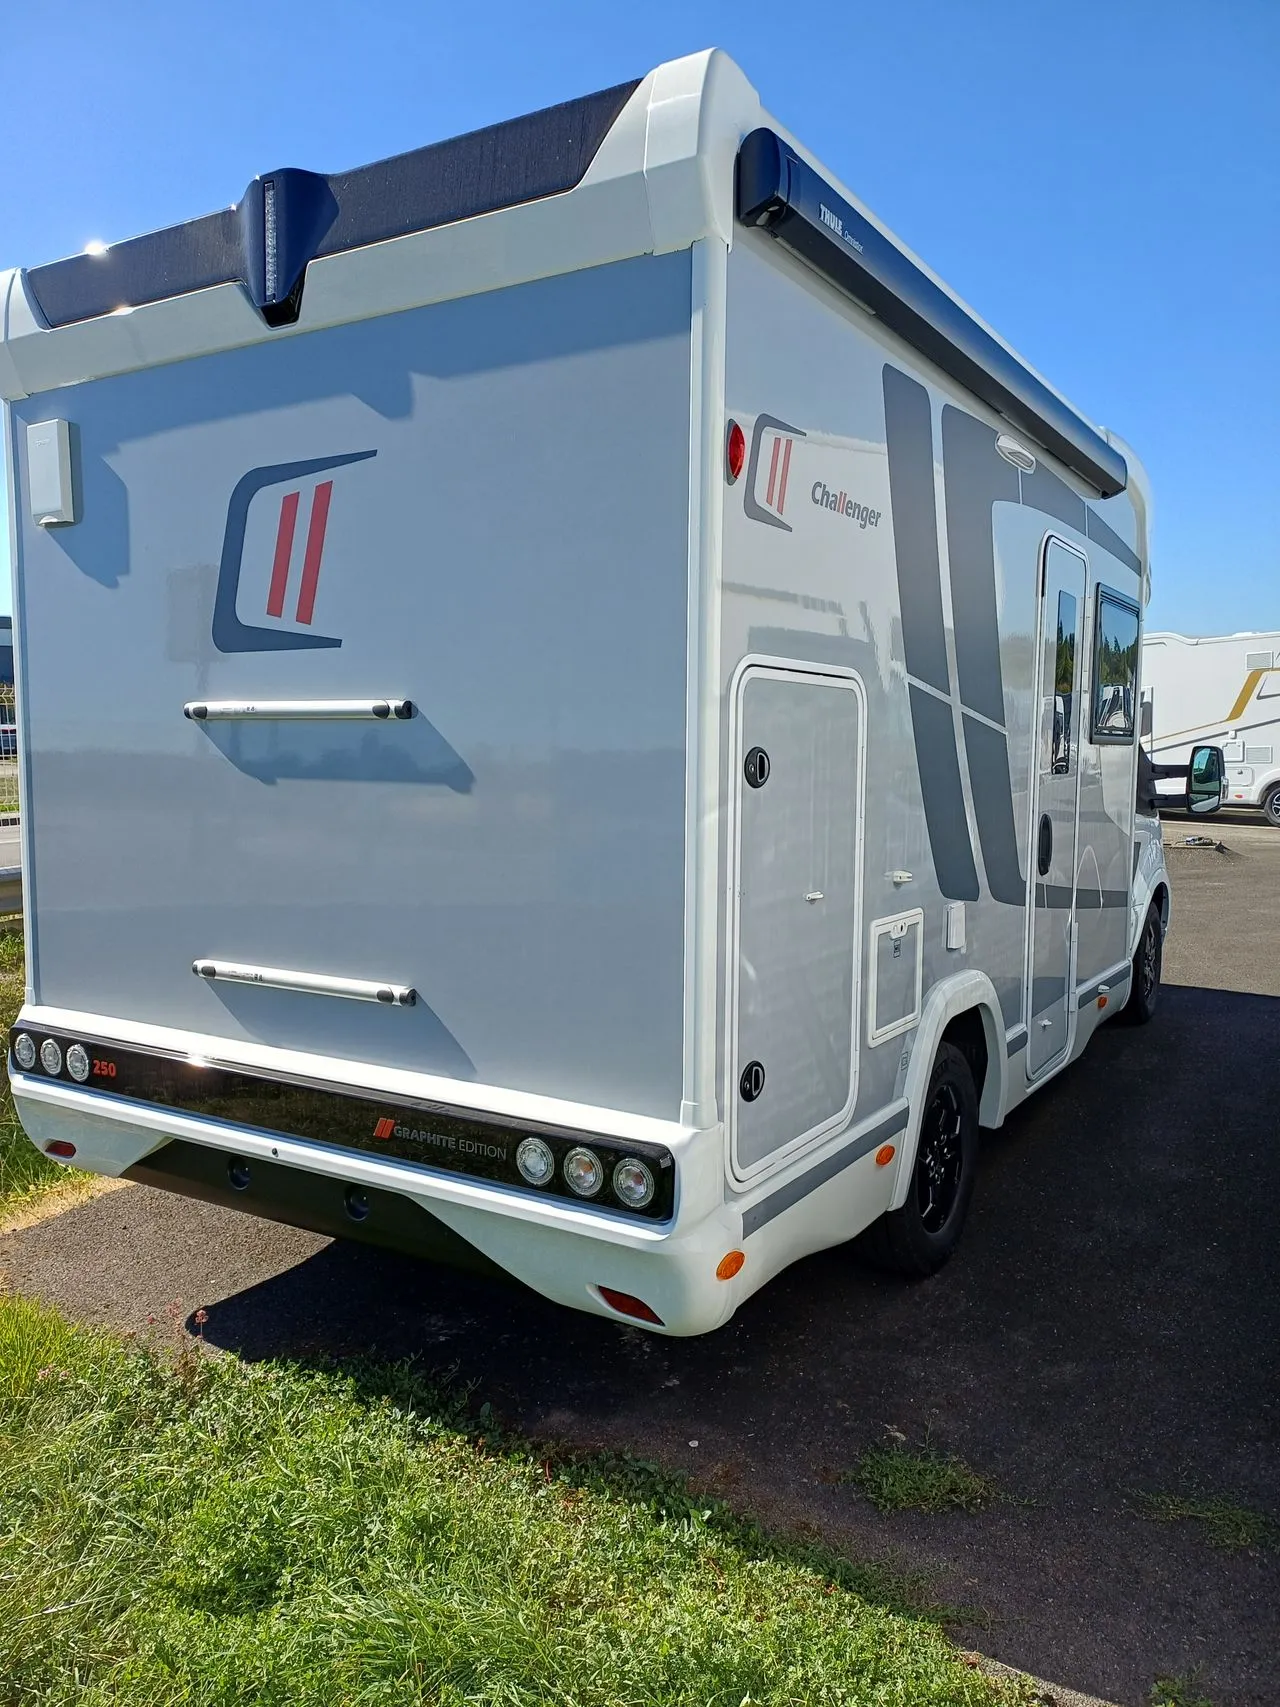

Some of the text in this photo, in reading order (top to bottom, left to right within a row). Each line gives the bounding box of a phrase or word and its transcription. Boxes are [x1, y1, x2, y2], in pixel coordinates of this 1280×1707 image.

[820, 203, 843, 236] THULE
[811, 481, 882, 529] Challenger
[93, 1059, 117, 1077] 250
[393, 1125, 507, 1160] GRAPHITE EDITION
